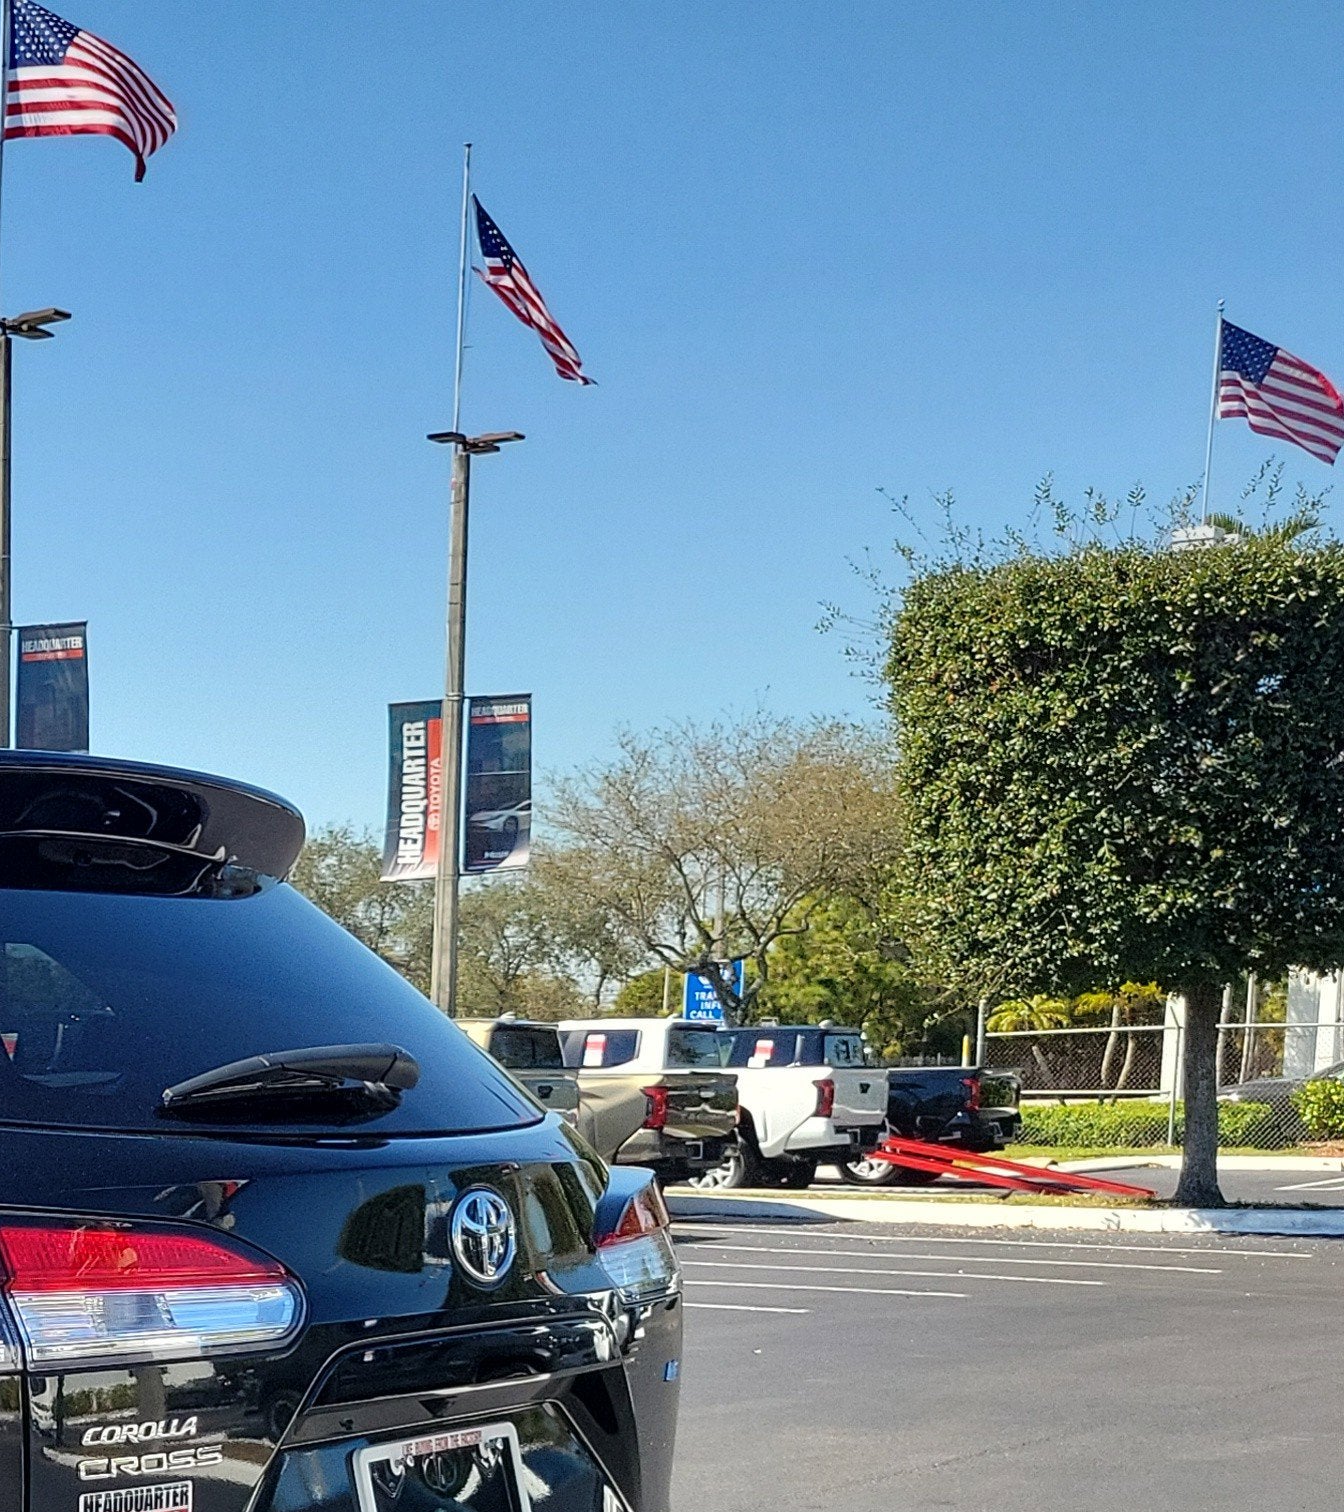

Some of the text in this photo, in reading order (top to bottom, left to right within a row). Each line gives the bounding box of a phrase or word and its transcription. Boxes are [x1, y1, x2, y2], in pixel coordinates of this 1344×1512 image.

[397, 721, 427, 865] HEADQUARTER
[690, 1010, 714, 1019] CALL
[81, 1416, 198, 1446] COROLLA
[78, 1445, 223, 1481] CROSS
